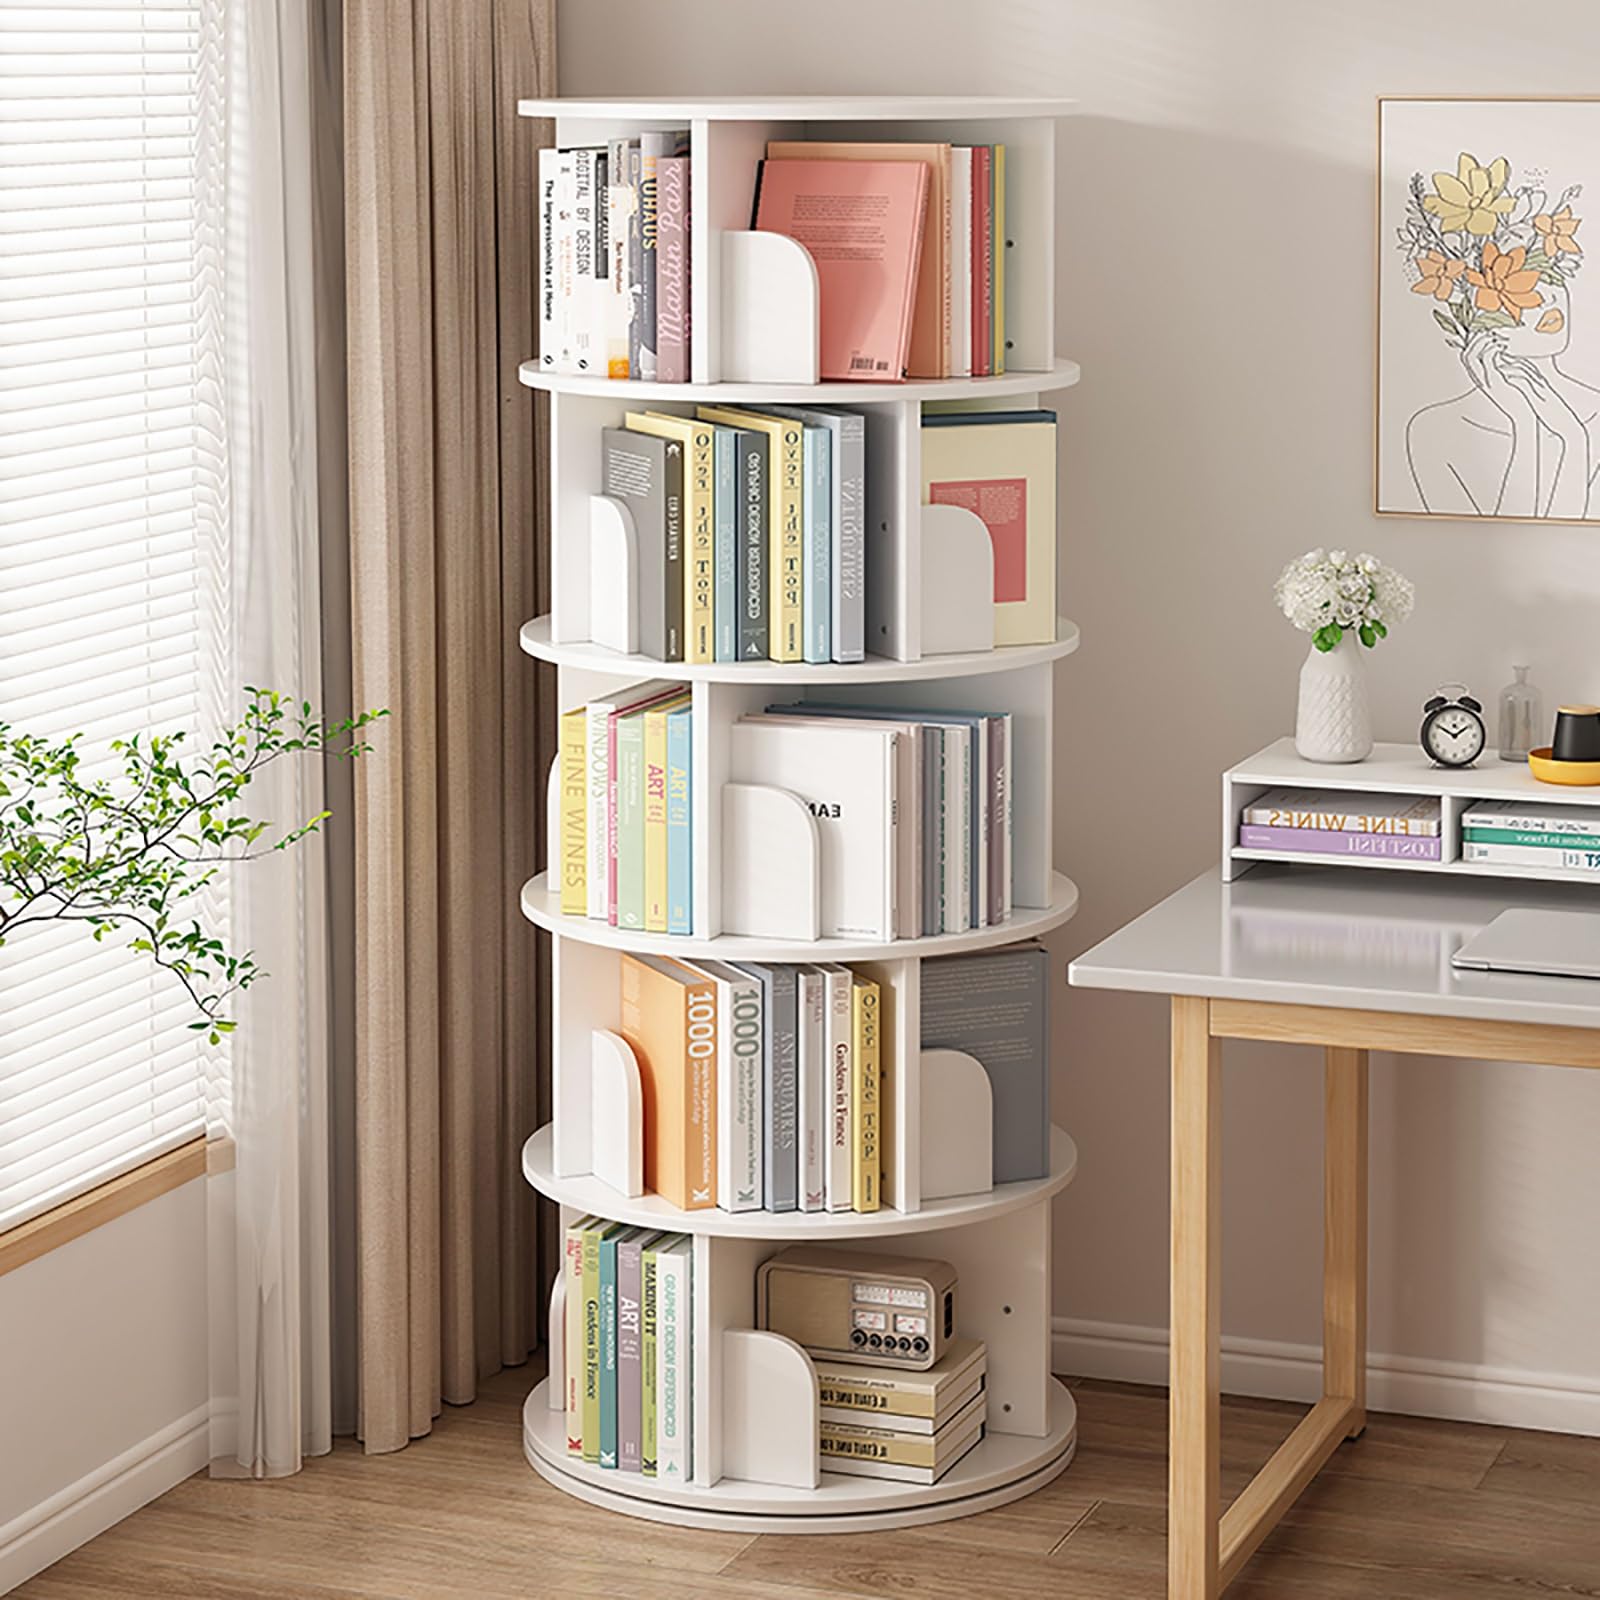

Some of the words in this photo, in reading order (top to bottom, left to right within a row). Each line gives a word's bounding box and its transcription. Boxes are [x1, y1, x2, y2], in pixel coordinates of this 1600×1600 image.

[544, 180, 554, 198] The
[576, 151, 590, 200] DIGITAL
[657, 159, 684, 232] Parr
[543, 201, 554, 276] Impressionists
[576, 208, 590, 223] BY
[576, 229, 590, 275] DESIGN
[544, 291, 554, 321] Home
[657, 241, 684, 348] Martin
[566, 743, 585, 797] FINE
[591, 710, 608, 800] WINDOWS
[648, 763, 665, 799] ART
[670, 765, 688, 801] ART
[566, 808, 585, 888] WINES
[687, 991, 715, 1058] 1000
[733, 989, 760, 1057] 1000
[776, 1030, 793, 1150] ANTIQUAIRES
[835, 1043, 848, 1091] Gardens
[835, 1093, 847, 1106] in
[835, 1108, 849, 1147] France
[645, 1262, 657, 1318] MAKING
[664, 1273, 677, 1322] GRAPHIC
[586, 1300, 599, 1345] Gardens
[621, 1297, 639, 1334] ART
[645, 1321, 657, 1337] IT
[587, 1348, 598, 1361] in
[664, 1325, 677, 1365] DESIGN
[586, 1362, 599, 1399] France
[664, 1366, 677, 1438] REFERENCED
